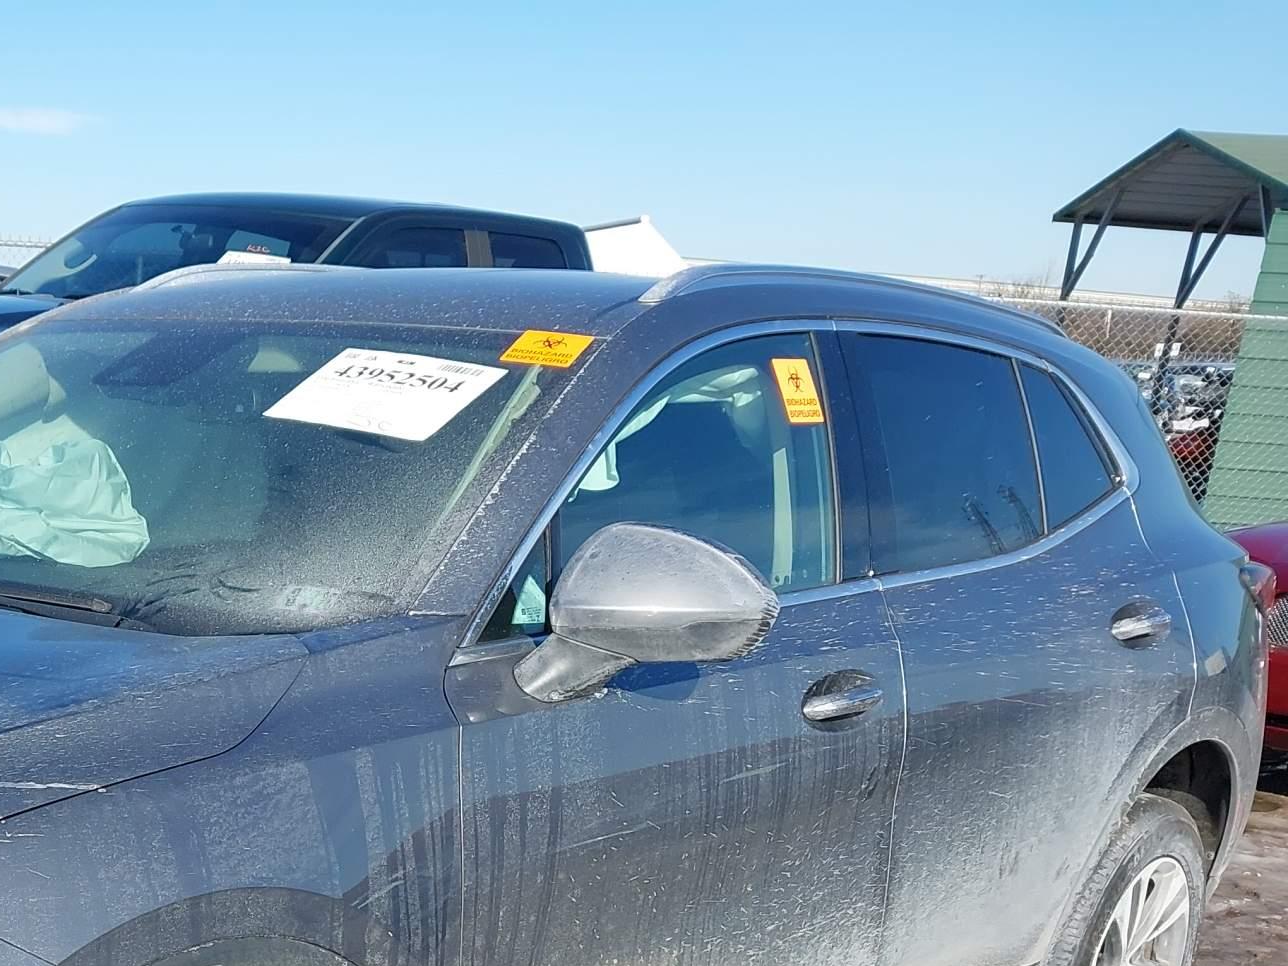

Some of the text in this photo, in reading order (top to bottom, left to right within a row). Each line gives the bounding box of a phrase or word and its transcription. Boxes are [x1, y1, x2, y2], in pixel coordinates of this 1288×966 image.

[505, 353, 568, 364] BIOPELIGRO
[511, 347, 572, 359] BIOHAZARD
[334, 365, 466, 393] 43952504
